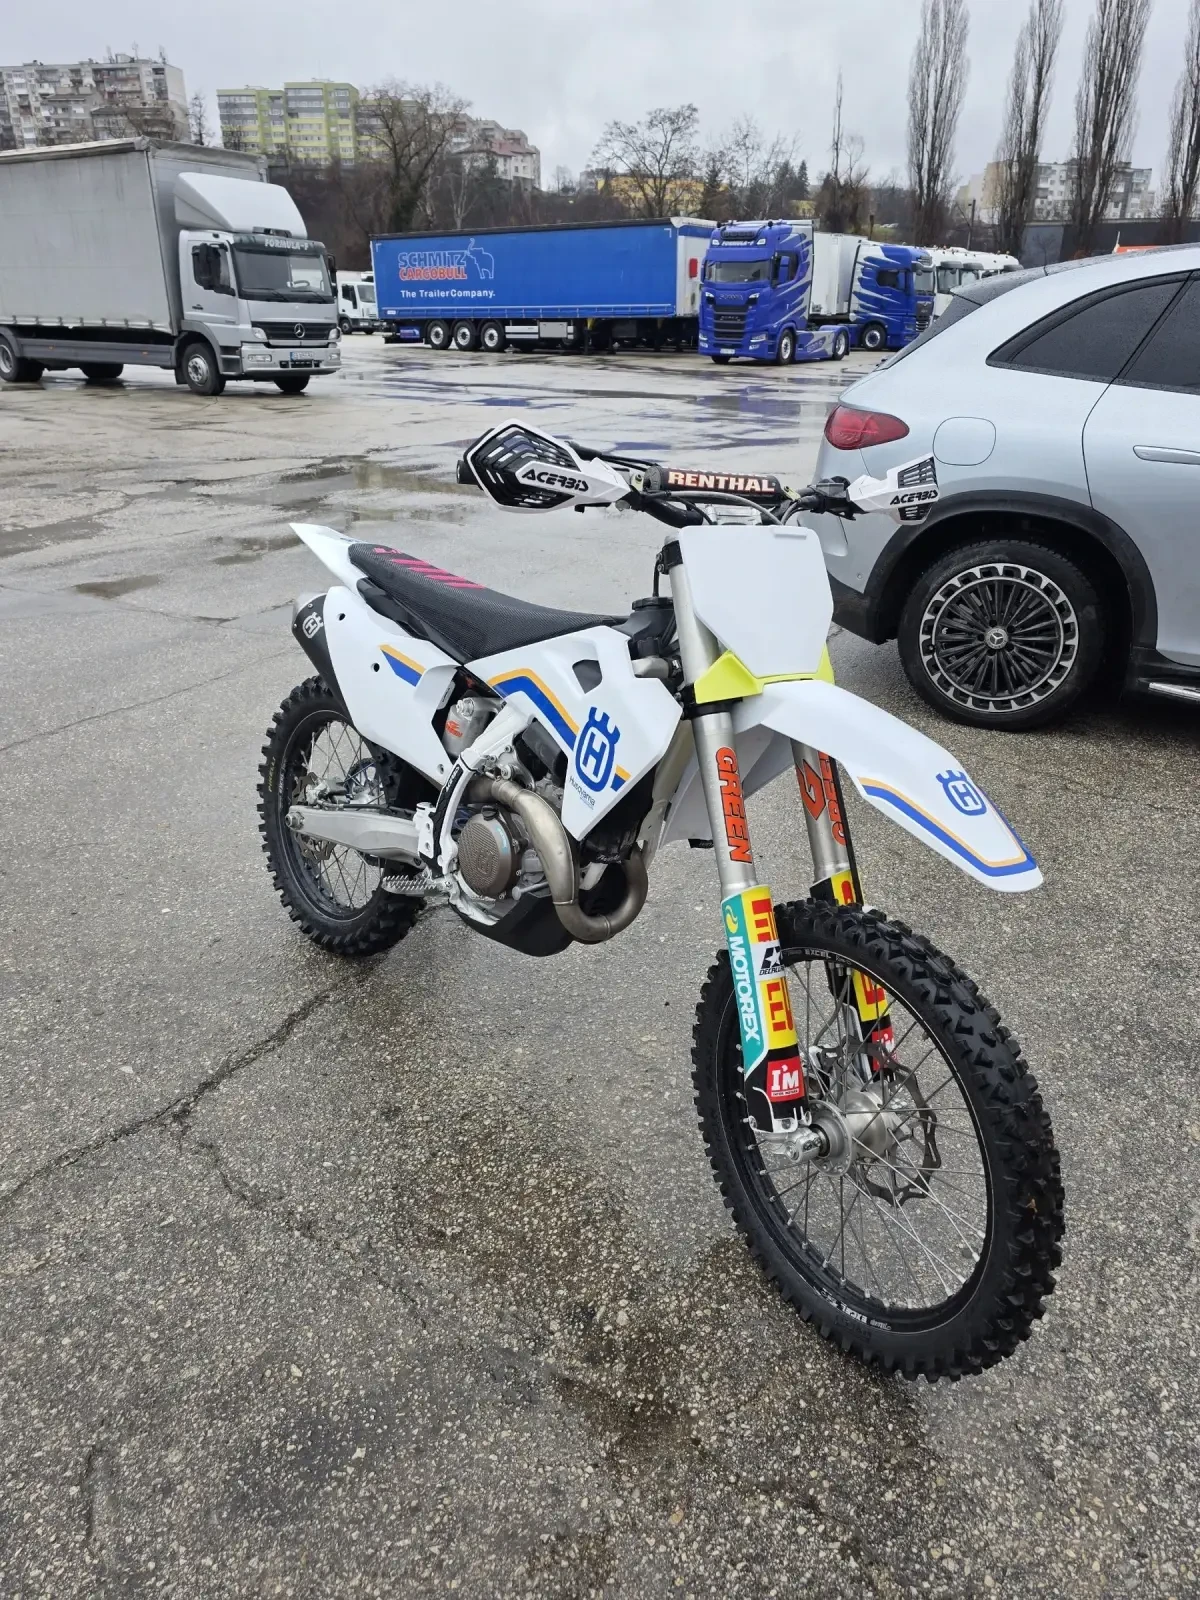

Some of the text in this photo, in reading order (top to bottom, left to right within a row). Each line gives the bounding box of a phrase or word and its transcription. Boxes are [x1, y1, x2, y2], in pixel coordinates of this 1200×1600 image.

[264, 238, 309, 250] FORMULA-F
[398, 250, 468, 268] SCHMITZ
[399, 266, 468, 281] CARGOBULL
[400, 289, 417, 299] The
[521, 468, 589, 492] ACERBIS
[667, 470, 776, 493] RENTHAL
[890, 489, 939, 505] ACERBIS
[715, 746, 753, 864] GREEN
[729, 935, 761, 1043] MOTOREX
